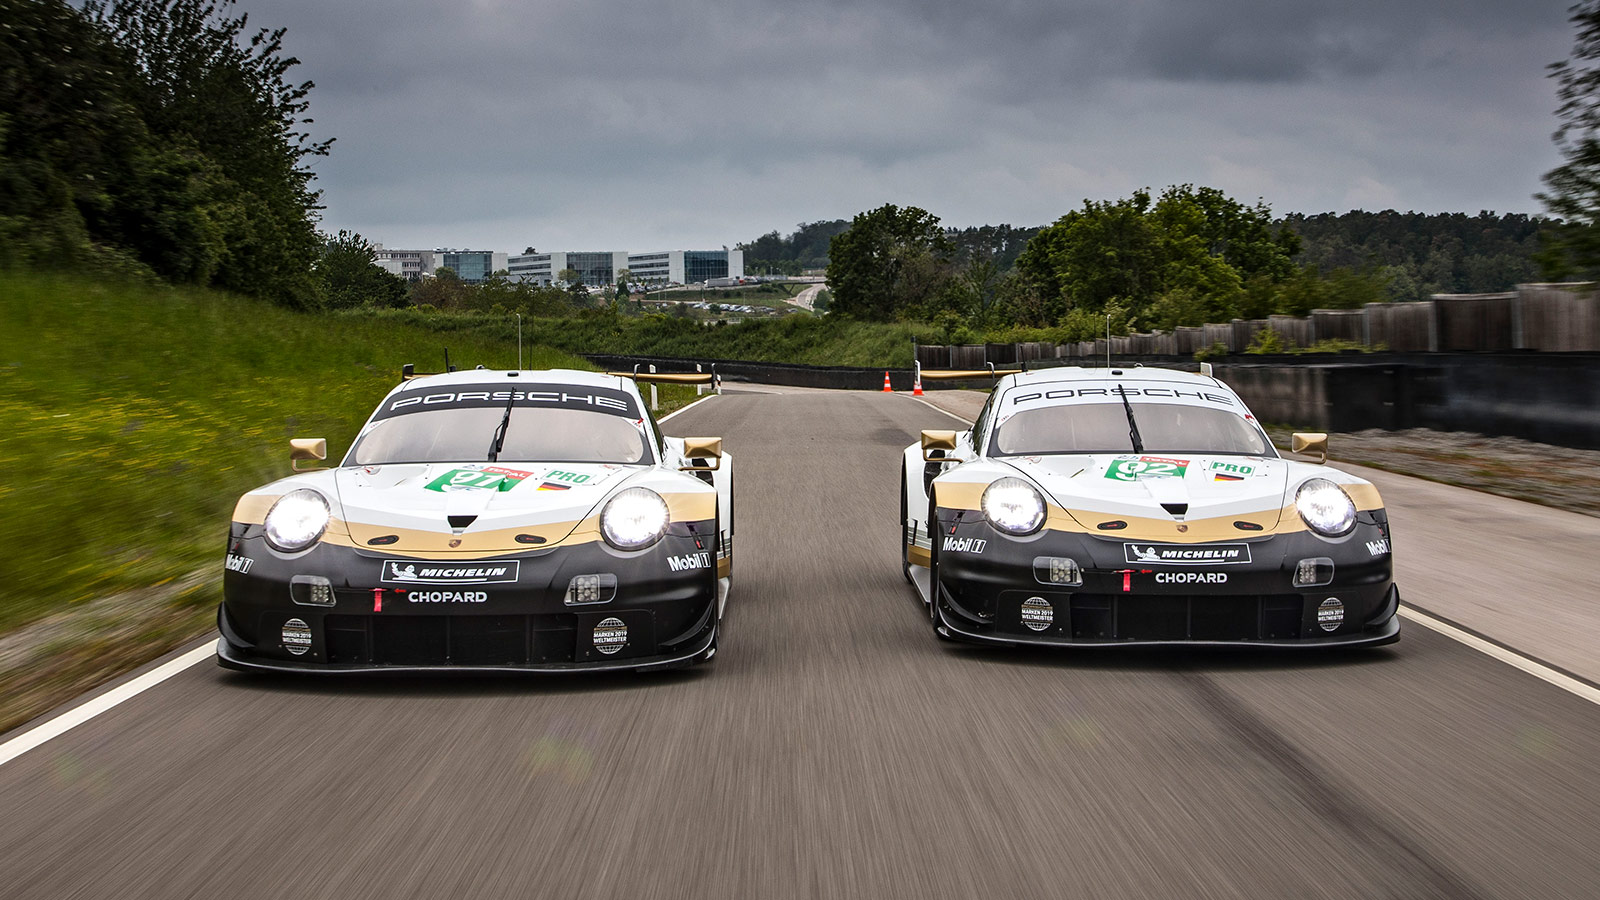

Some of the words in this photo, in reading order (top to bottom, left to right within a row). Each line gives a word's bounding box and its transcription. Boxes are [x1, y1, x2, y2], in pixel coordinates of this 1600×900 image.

[390, 391, 628, 412] PORSCHE
[1014, 388, 1234, 406] PORSCHE
[1115, 461, 1178, 481] 92
[1212, 462, 1252, 474] PRO
[441, 471, 507, 492] 91
[546, 470, 591, 483] PRO
[942, 536, 973, 552] Mobil
[1161, 549, 1239, 559] MICHELIN
[666, 553, 702, 572] Mobil
[419, 567, 507, 577] MICHELIN
[1155, 572, 1228, 584] CHOPARD
[408, 591, 488, 603] CHOPARD
